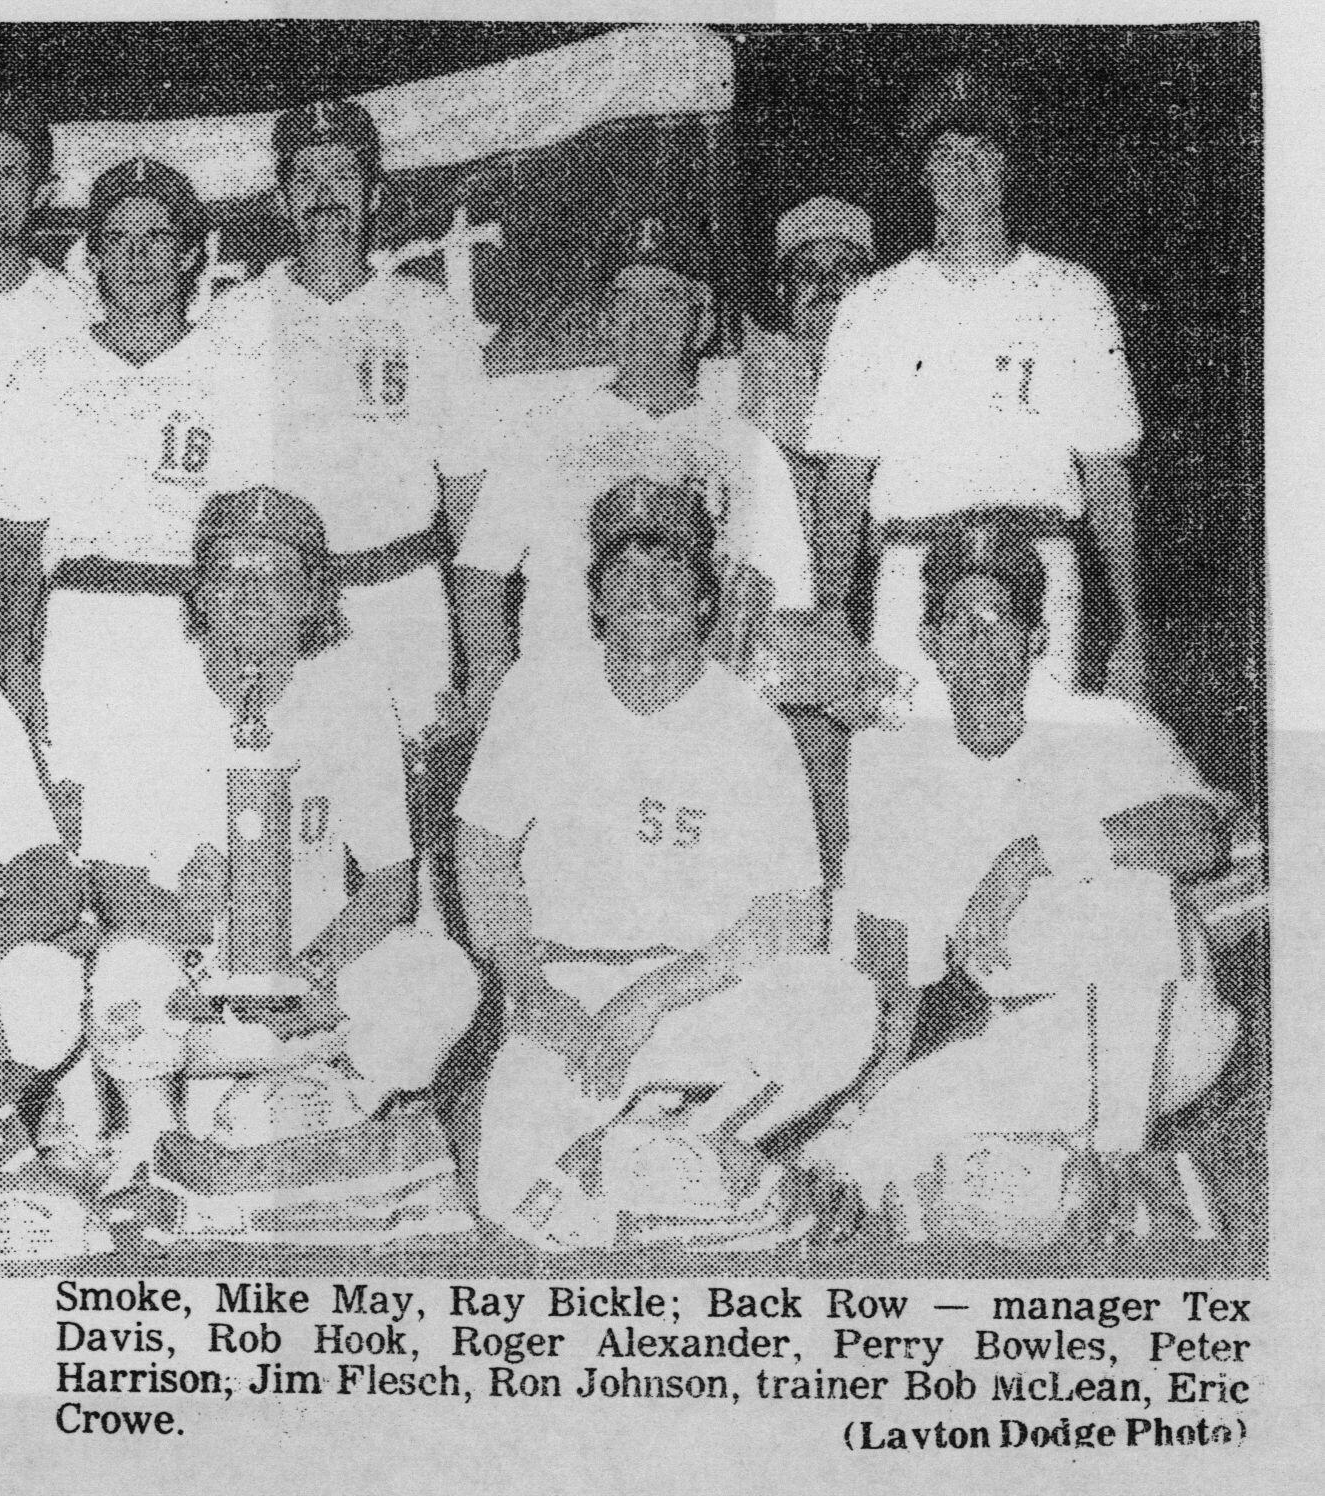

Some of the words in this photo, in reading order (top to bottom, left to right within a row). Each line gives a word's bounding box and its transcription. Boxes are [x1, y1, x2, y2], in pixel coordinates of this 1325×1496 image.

[56, 1280, 192, 1319] Smoke,
[216, 1282, 310, 1314] Mike
[332, 1283, 425, 1323] May,
[449, 1285, 525, 1324] Ray
[548, 1285, 680, 1321] Bickle;
[707, 1286, 803, 1319] Back
[826, 1288, 908, 1319] Row
[993, 1296, 1161, 1329] manager
[1182, 1291, 1251, 1322] Tex
[56, 1320, 175, 1359] Davis,
[208, 1322, 282, 1354] Rob
[314, 1323, 419, 1362] Hook,
[452, 1325, 566, 1365] Roger
[597, 1325, 802, 1362] Alexander,
[834, 1328, 944, 1368] Perry
[974, 1328, 1118, 1366] Bowles,
[1149, 1331, 1251, 1363] Peter
[248, 1362, 323, 1395] Jim
[337, 1363, 472, 1404] Flesch,
[489, 1366, 561, 1398] Ron
[576, 1366, 740, 1405] Johnson,
[756, 1369, 889, 1400] trainer
[904, 1368, 977, 1401] Bob
[991, 1371, 1151, 1410] McLean,
[1167, 1371, 1250, 1405] Eric
[55, 1401, 184, 1436] Crowe.
